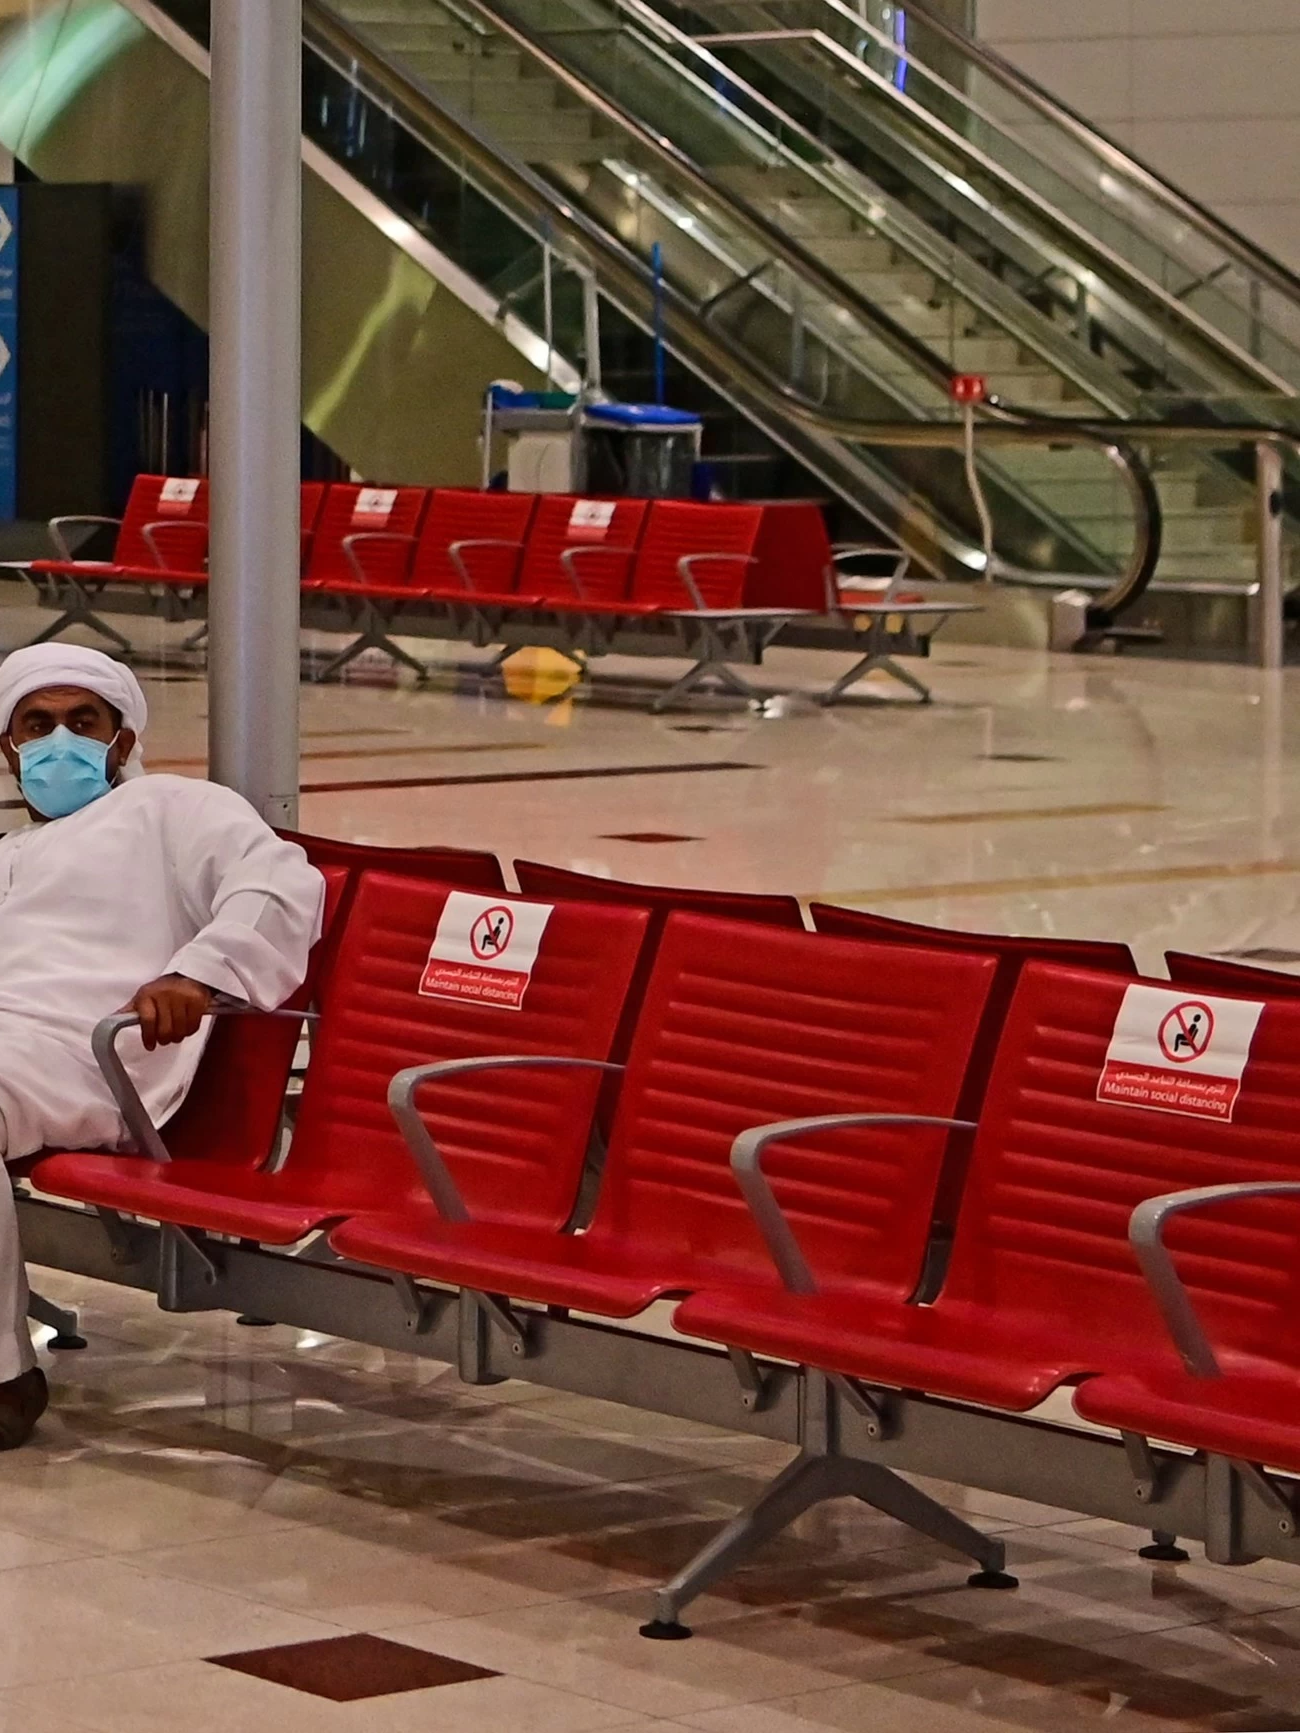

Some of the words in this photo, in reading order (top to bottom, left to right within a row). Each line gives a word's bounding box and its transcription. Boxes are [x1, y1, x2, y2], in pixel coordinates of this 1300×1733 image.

[425, 978, 460, 991] Maintain
[460, 984, 483, 995] social
[482, 987, 518, 1004] distancing
[1104, 1081, 1149, 1098] Maintain
[1150, 1089, 1178, 1103] social
[1179, 1094, 1227, 1114] distancing
